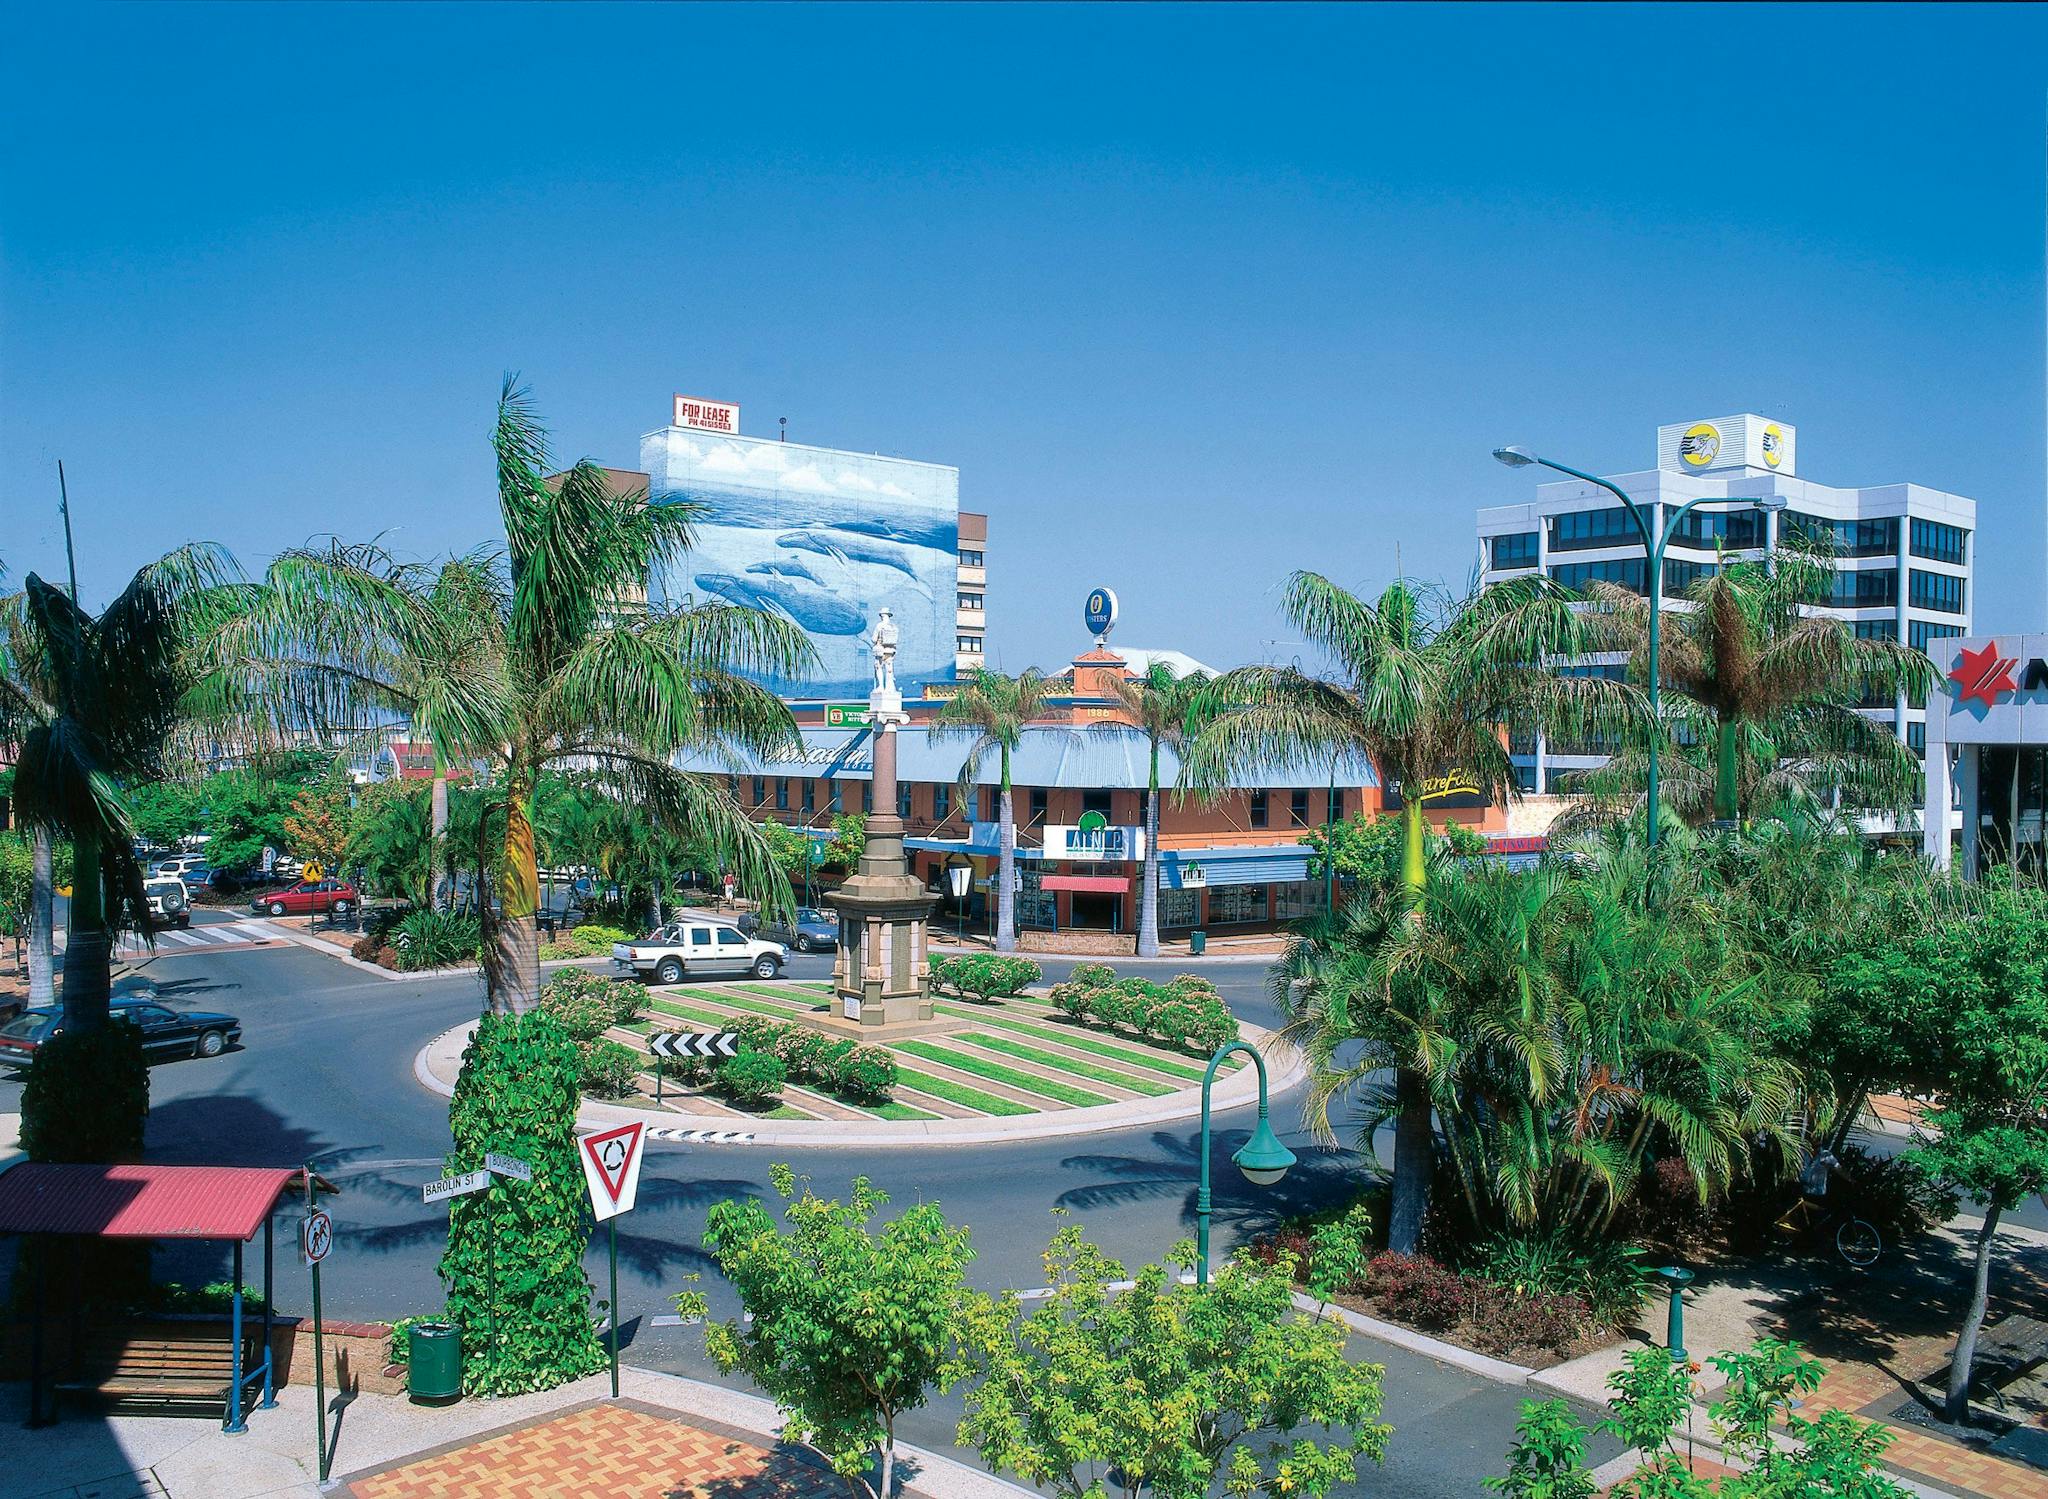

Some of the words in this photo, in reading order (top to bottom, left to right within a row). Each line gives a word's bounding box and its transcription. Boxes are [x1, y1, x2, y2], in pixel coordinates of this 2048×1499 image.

[682, 403, 700, 418] FOR
[702, 406, 731, 423] LEASE
[688, 418, 698, 426] PH
[1087, 708, 1110, 717] 1986
[425, 1178, 461, 1196] BAROLIN
[464, 1174, 475, 1186] ST
